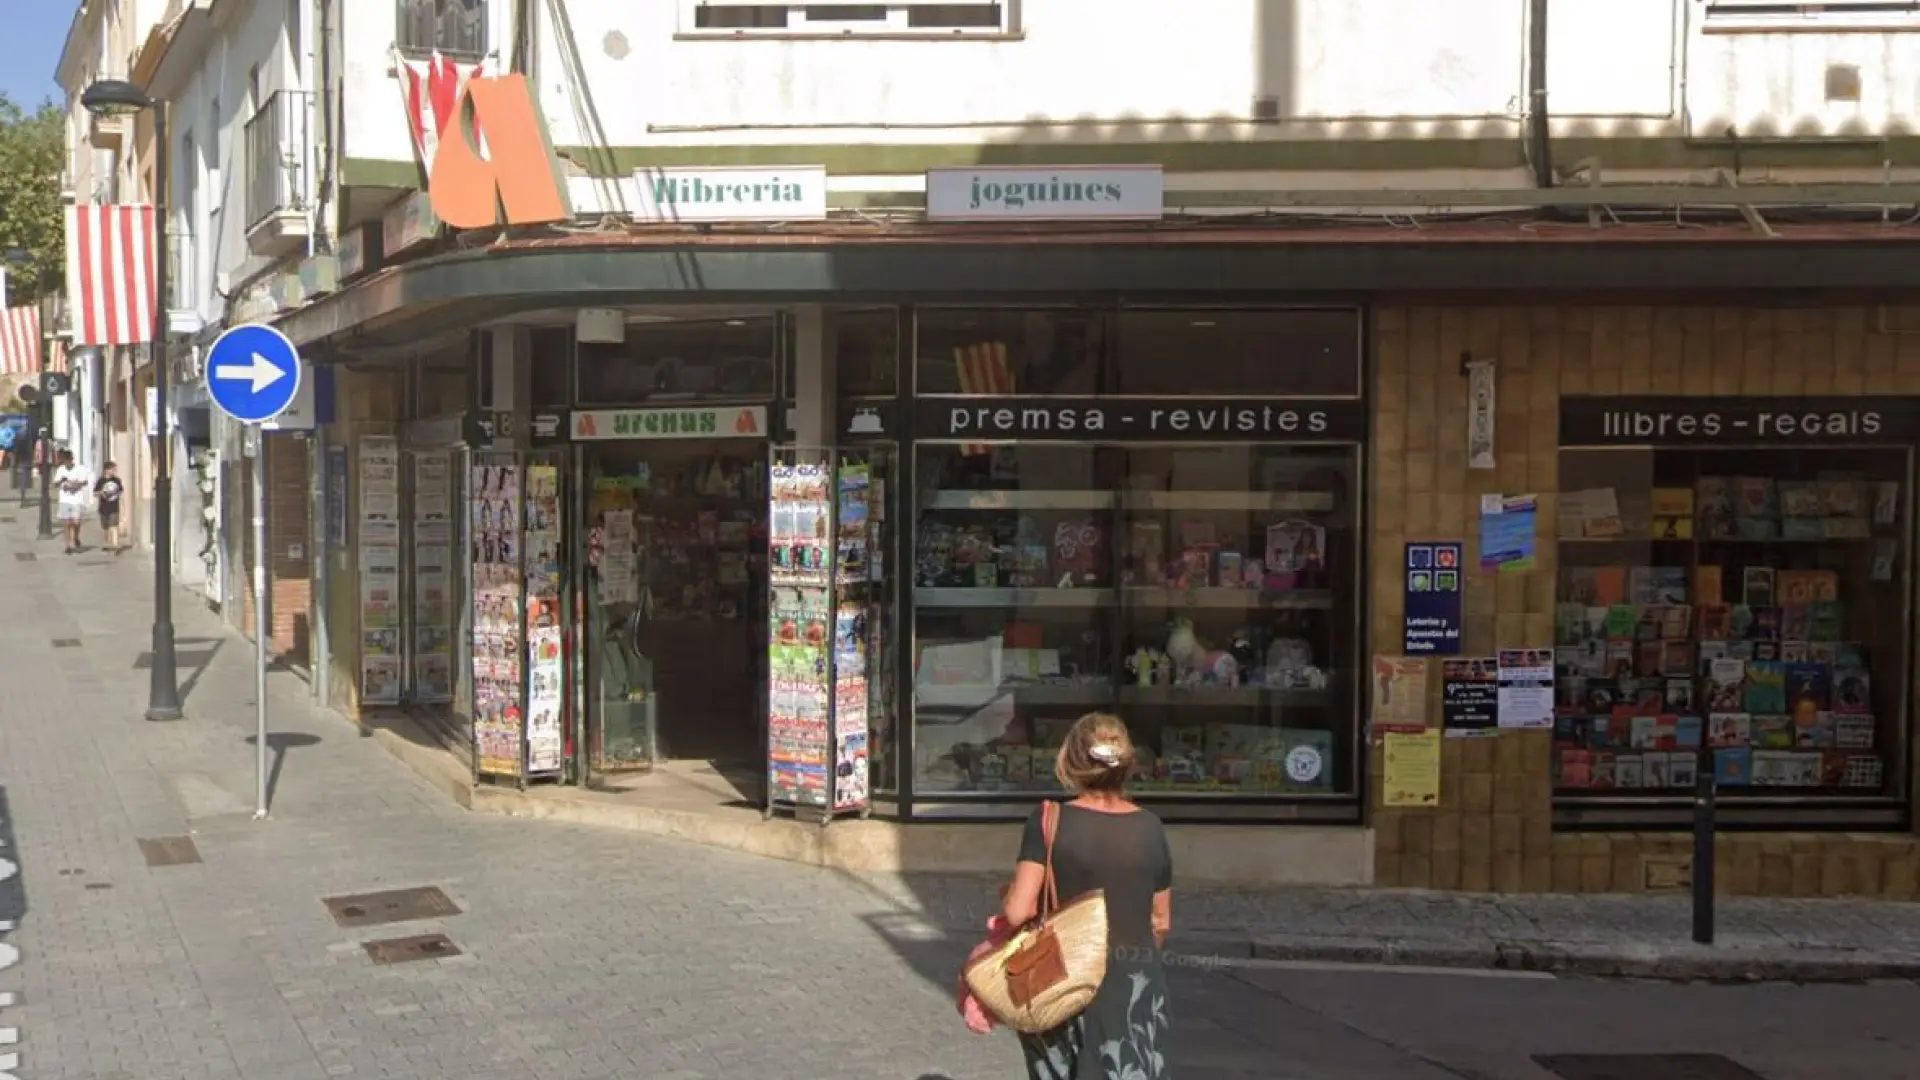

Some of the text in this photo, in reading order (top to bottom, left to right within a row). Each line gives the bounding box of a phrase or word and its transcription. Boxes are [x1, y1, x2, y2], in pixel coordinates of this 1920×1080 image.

[655, 177, 803, 204] llibreria
[970, 175, 1122, 209] joguines
[950, 406, 1105, 433] premsa
[1149, 405, 1329, 432] revistes
[1603, 411, 1722, 436] llibres
